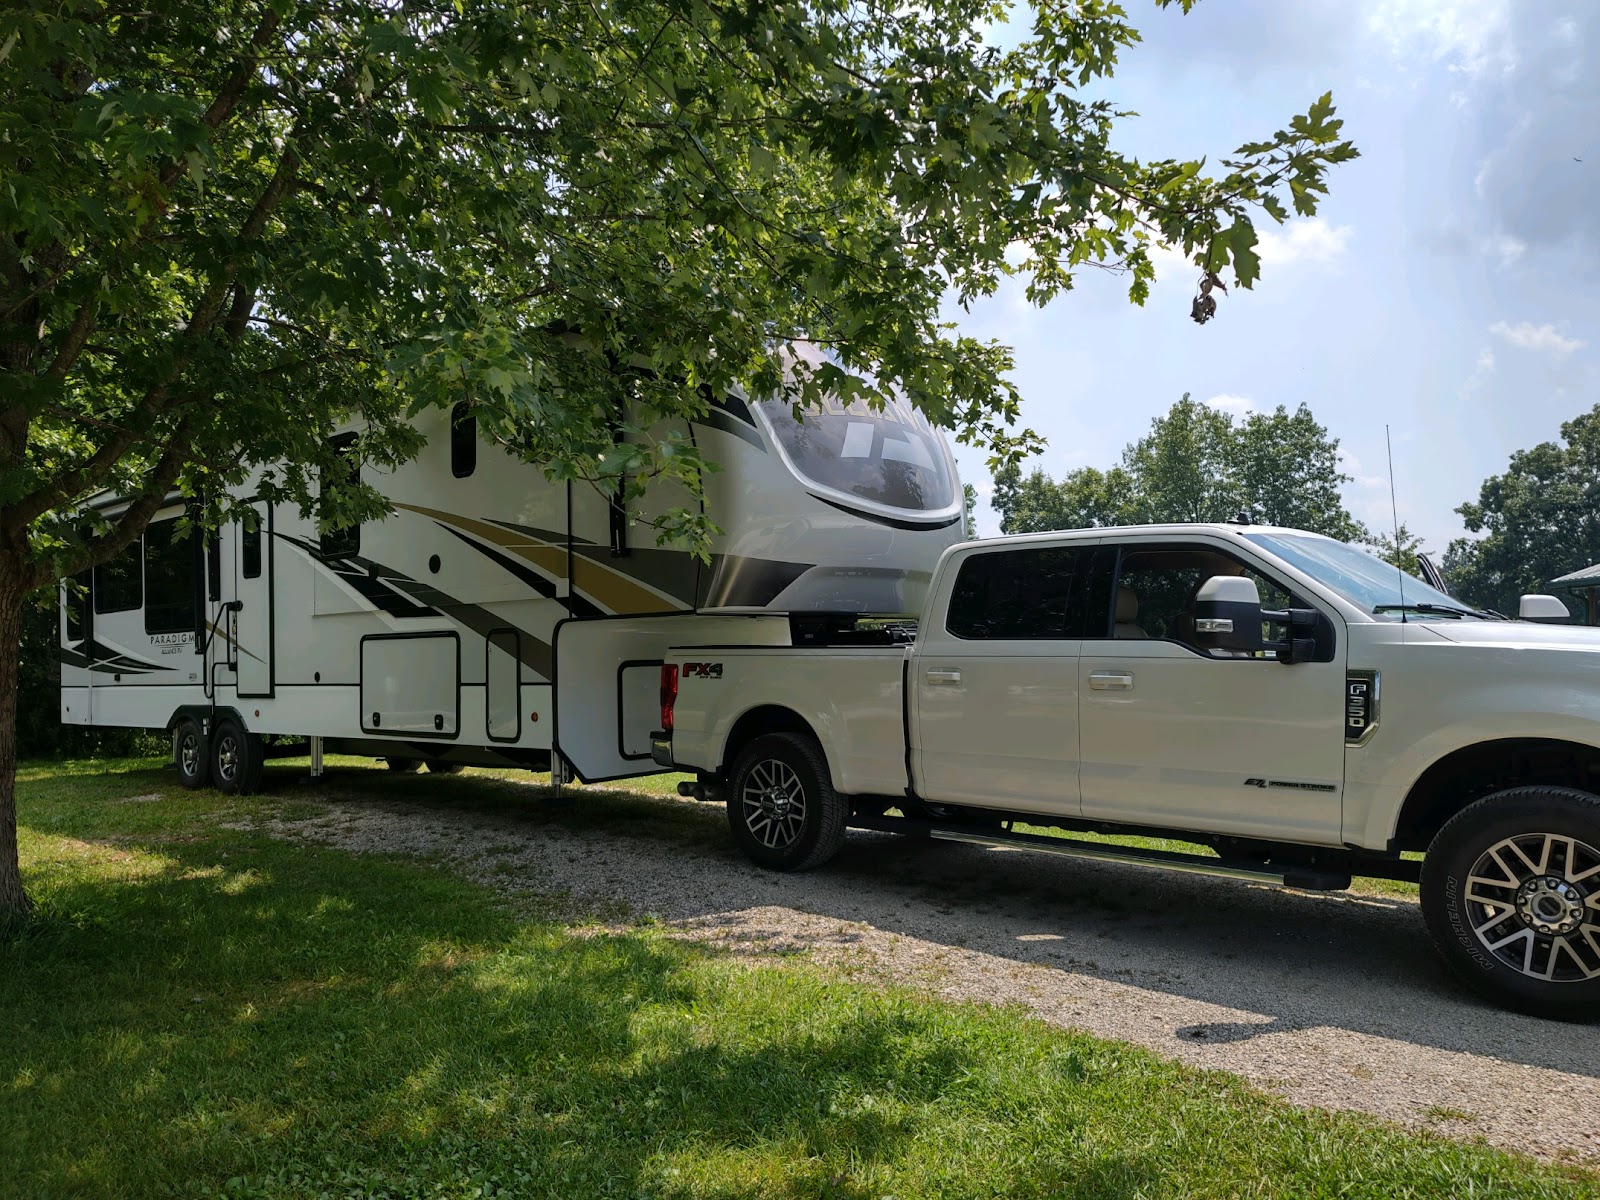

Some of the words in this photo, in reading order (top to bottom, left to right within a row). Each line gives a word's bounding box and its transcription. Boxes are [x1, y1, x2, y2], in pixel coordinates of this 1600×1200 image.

[150, 634, 194, 644] PARADIGM
[683, 663, 723, 677] FX4
[1349, 684, 1366, 727] F350
[1446, 875, 1495, 970] MICHELIN
